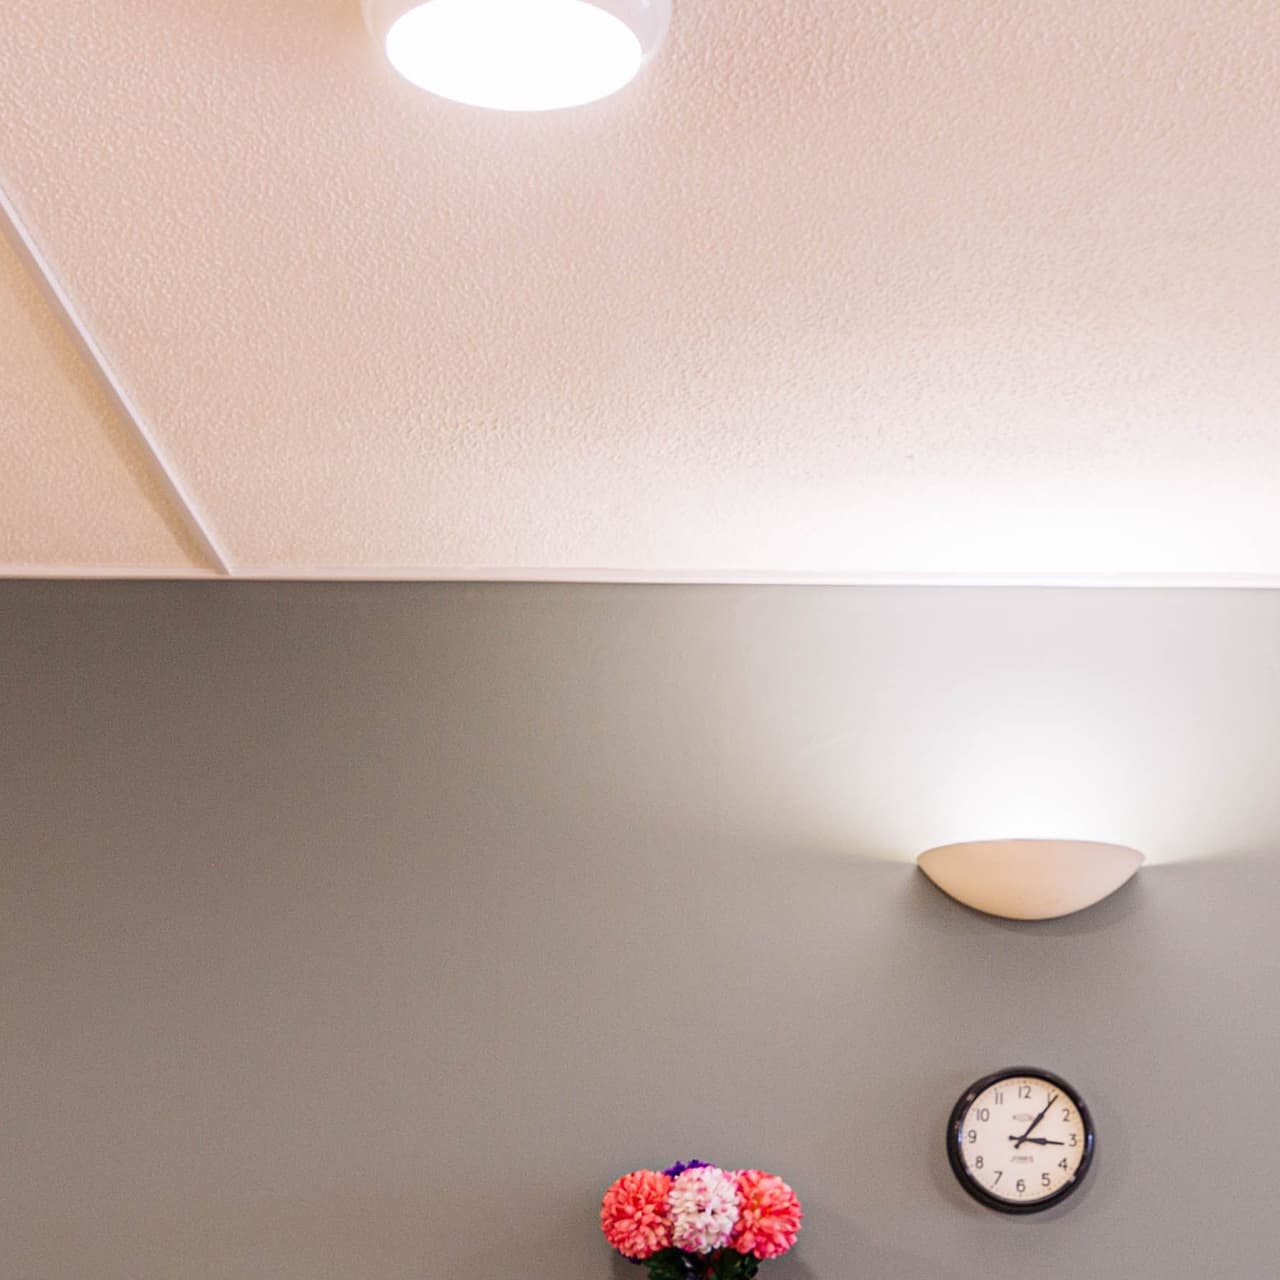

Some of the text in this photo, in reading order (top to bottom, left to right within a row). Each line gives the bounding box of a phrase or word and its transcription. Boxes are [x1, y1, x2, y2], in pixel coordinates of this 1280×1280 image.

[994, 1092, 1004, 1105] 11
[1018, 1085, 1032, 1099] 12
[976, 1108, 990, 1122] 10
[1062, 1109, 1070, 1121] 2
[967, 1130, 977, 1144] 9
[1068, 1133, 1078, 1147] 3
[975, 1156, 984, 1169] 8
[1058, 1158, 1068, 1171] 4
[993, 1171, 1003, 1185] 7
[1041, 1173, 1051, 1187] 5
[1016, 1179, 1026, 1192] 6
